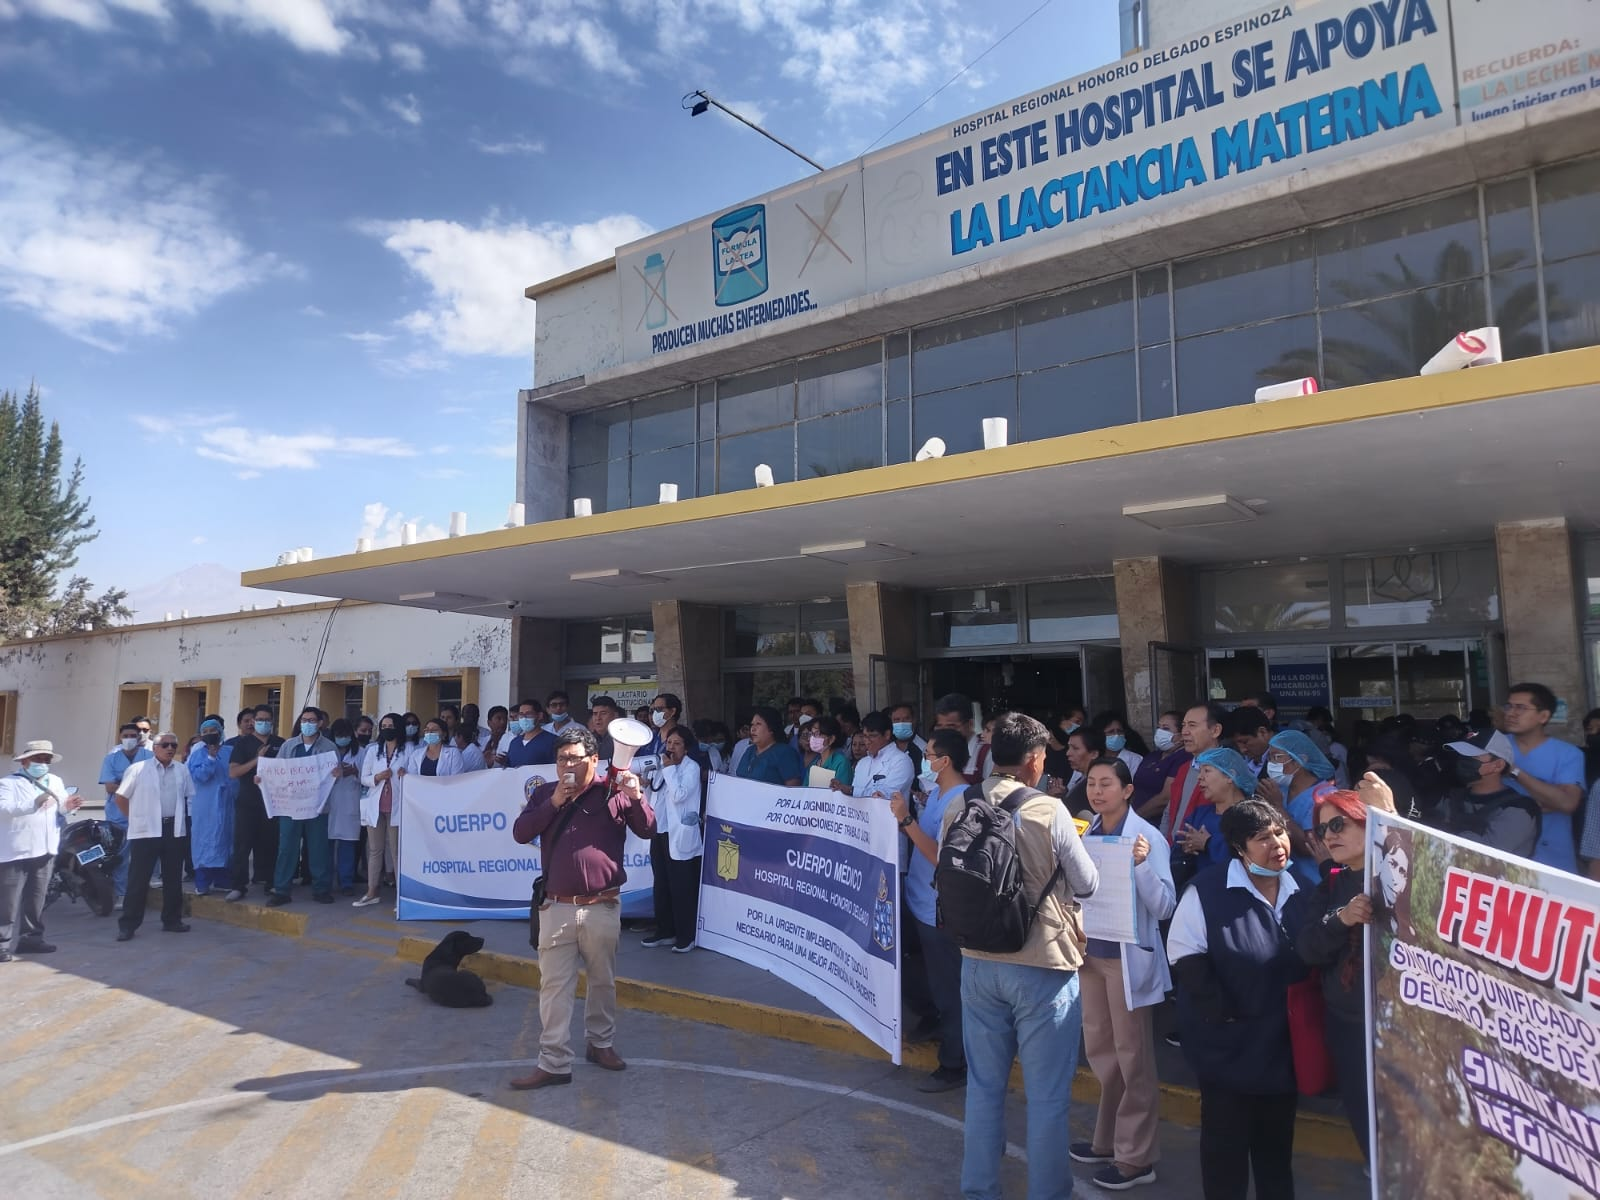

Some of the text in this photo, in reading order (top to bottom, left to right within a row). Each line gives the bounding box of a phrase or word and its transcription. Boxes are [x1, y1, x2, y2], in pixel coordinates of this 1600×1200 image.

[953, 5, 1293, 137] HOSPITAL REGIONAL HONORIO DELGADO ESPINOZA
[1462, 38, 1580, 84] RECUERDA:
[1482, 80, 1508, 101] LA
[1514, 57, 1581, 92] LECHE
[936, 0, 1438, 197] EN ESTE HOSPITAL SE APOYA
[951, 62, 1443, 256] LA LACTANCIA MATERNA
[652, 289, 818, 354] PRODUCEN MUCHAS ENFERMEDADES...
[618, 690, 647, 698] LACTARIO
[434, 811, 507, 833] CUERPO
[766, 812, 782, 823] POR
[783, 813, 834, 832] CONDICIONES
[834, 822, 843, 834] DE
[775, 798, 791, 809] POR
[791, 799, 801, 810] LA
[803, 800, 835, 814] DIGNIDAD
[836, 804, 847, 817] DEL
[423, 860, 476, 874] HOSPITAL
[479, 857, 541, 873] REGIONAL
[786, 849, 862, 891] CUERPO MÉDICO
[754, 869, 794, 889] HOSPITAL
[795, 880, 828, 902] REGIONAL
[829, 892, 853, 914] HONORIO
[736, 921, 776, 944] NECESARIO
[776, 935, 794, 953] PARA
[794, 944, 807, 960] UNA
[807, 951, 827, 970] MEJOR
[747, 908, 763, 923] POR
[764, 913, 774, 926] LA
[775, 917, 805, 938] URGENTE
[1439, 871, 1600, 998] FENUT
[1394, 943, 1596, 1047] SINDICATO UNIFICADO
[1404, 977, 1483, 1031] DELGADO
[1500, 1018, 1552, 1064] BASE
[1557, 1043, 1590, 1081] DE
